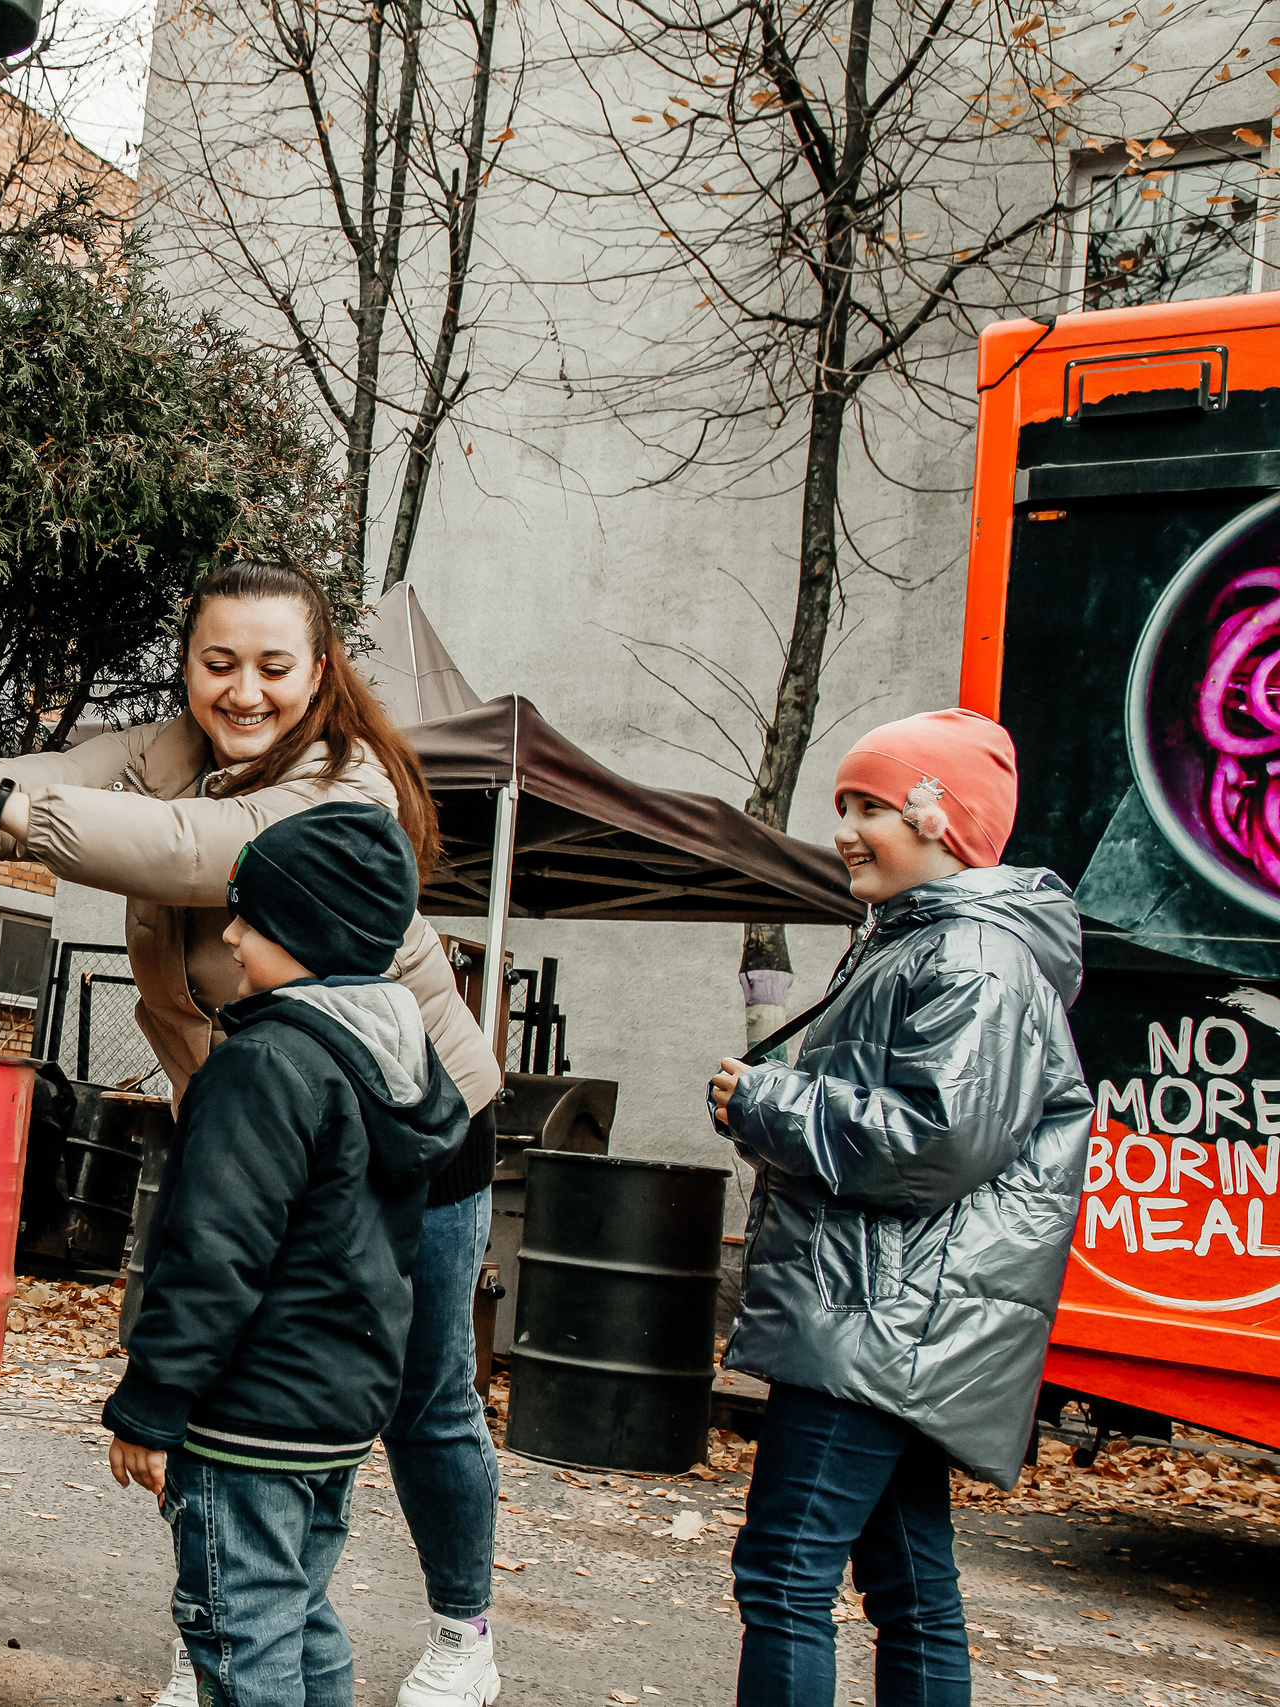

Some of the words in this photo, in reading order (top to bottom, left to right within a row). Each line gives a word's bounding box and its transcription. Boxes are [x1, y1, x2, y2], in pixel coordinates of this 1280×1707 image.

[1148, 1016, 1249, 1075] NO
[1096, 1075, 1280, 1135] MORE
[1083, 1135, 1280, 1195] BORIN
[1084, 1195, 1280, 1256] MEAL
